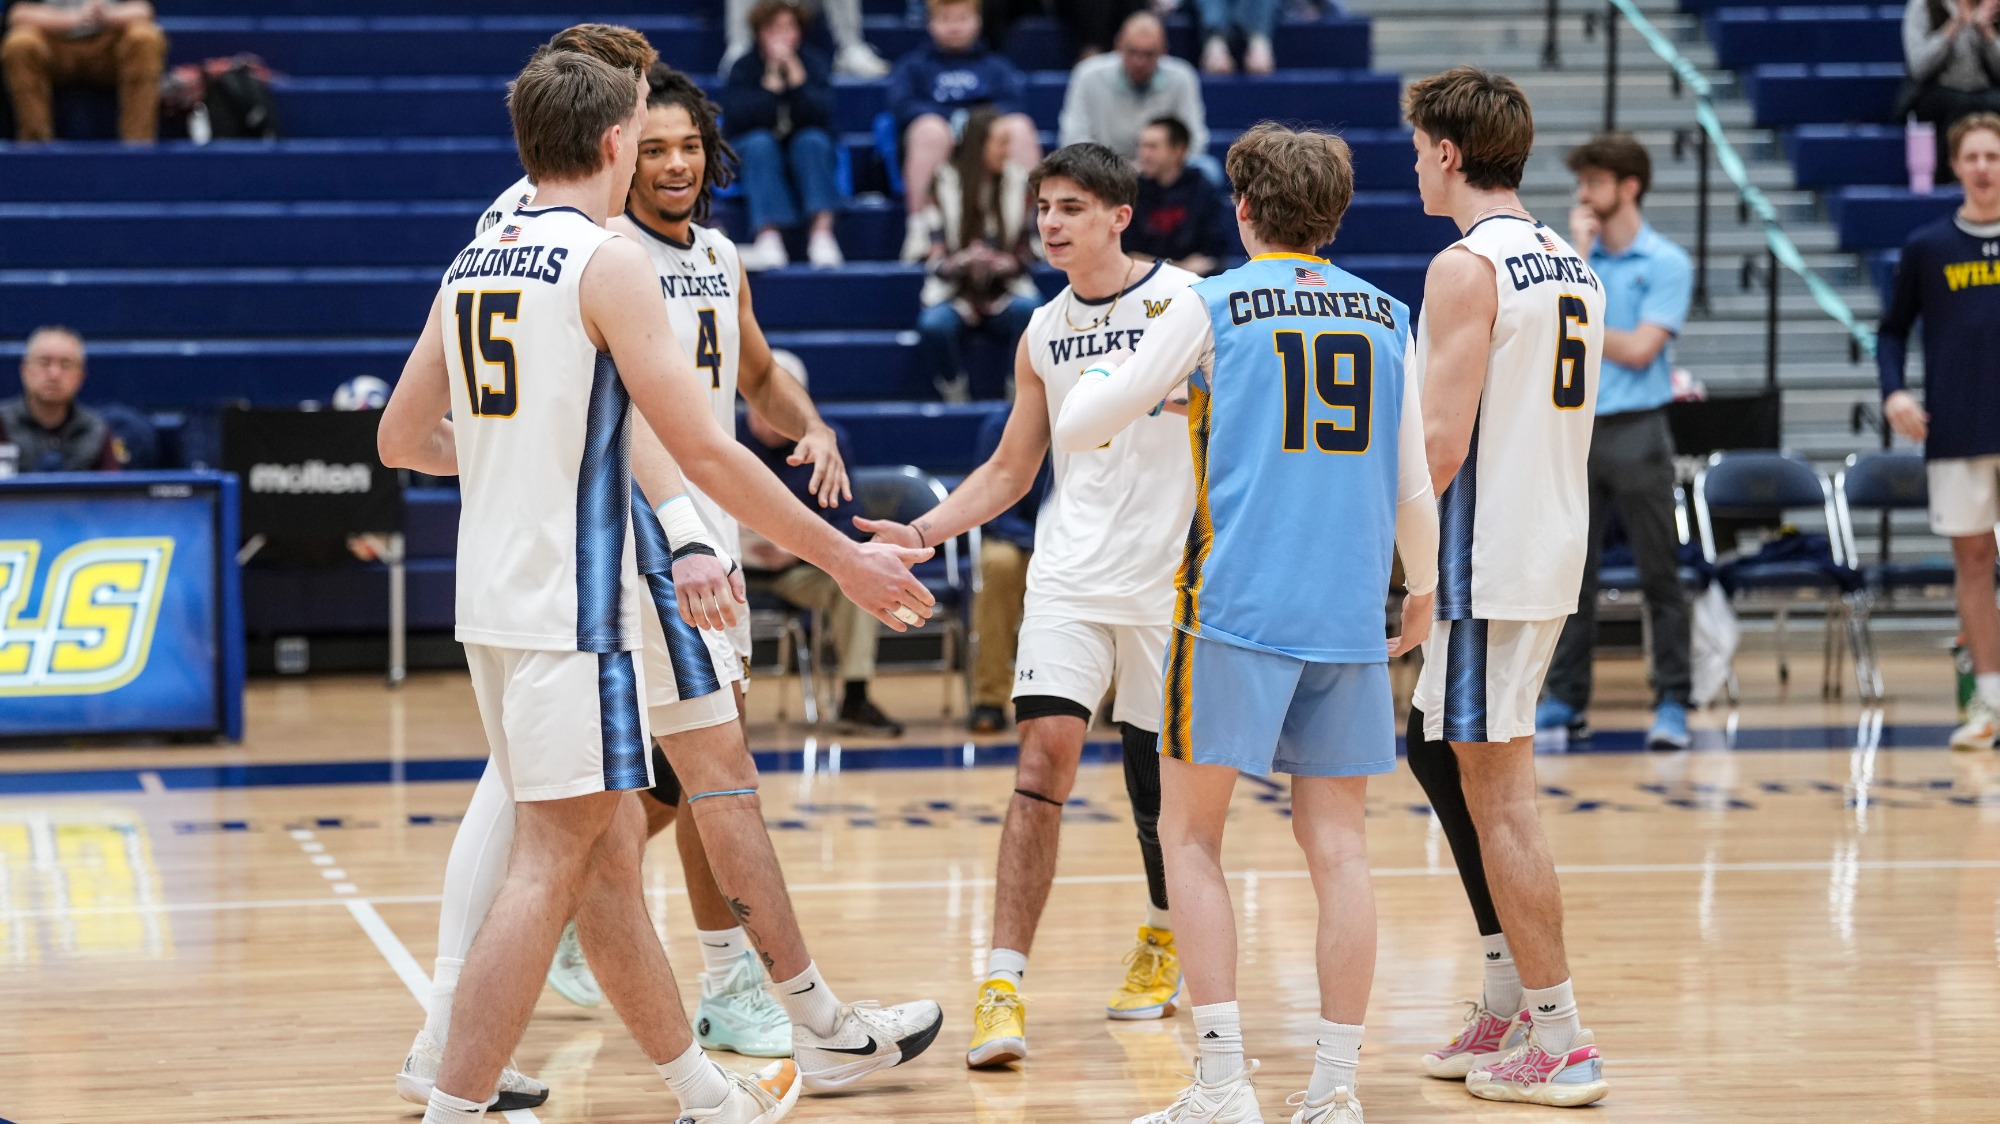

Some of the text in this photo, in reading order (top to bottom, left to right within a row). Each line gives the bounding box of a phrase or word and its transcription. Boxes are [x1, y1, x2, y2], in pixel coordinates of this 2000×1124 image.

[447, 246, 569, 285] COLONELS
[1229, 288, 1395, 330] COLONELS
[455, 290, 522, 418] 15
[696, 308, 722, 389] 4
[1049, 329, 1144, 365] WILKE
[1552, 293, 1588, 411] 6
[1273, 329, 1373, 454] 19
[249, 459, 372, 494] molten
